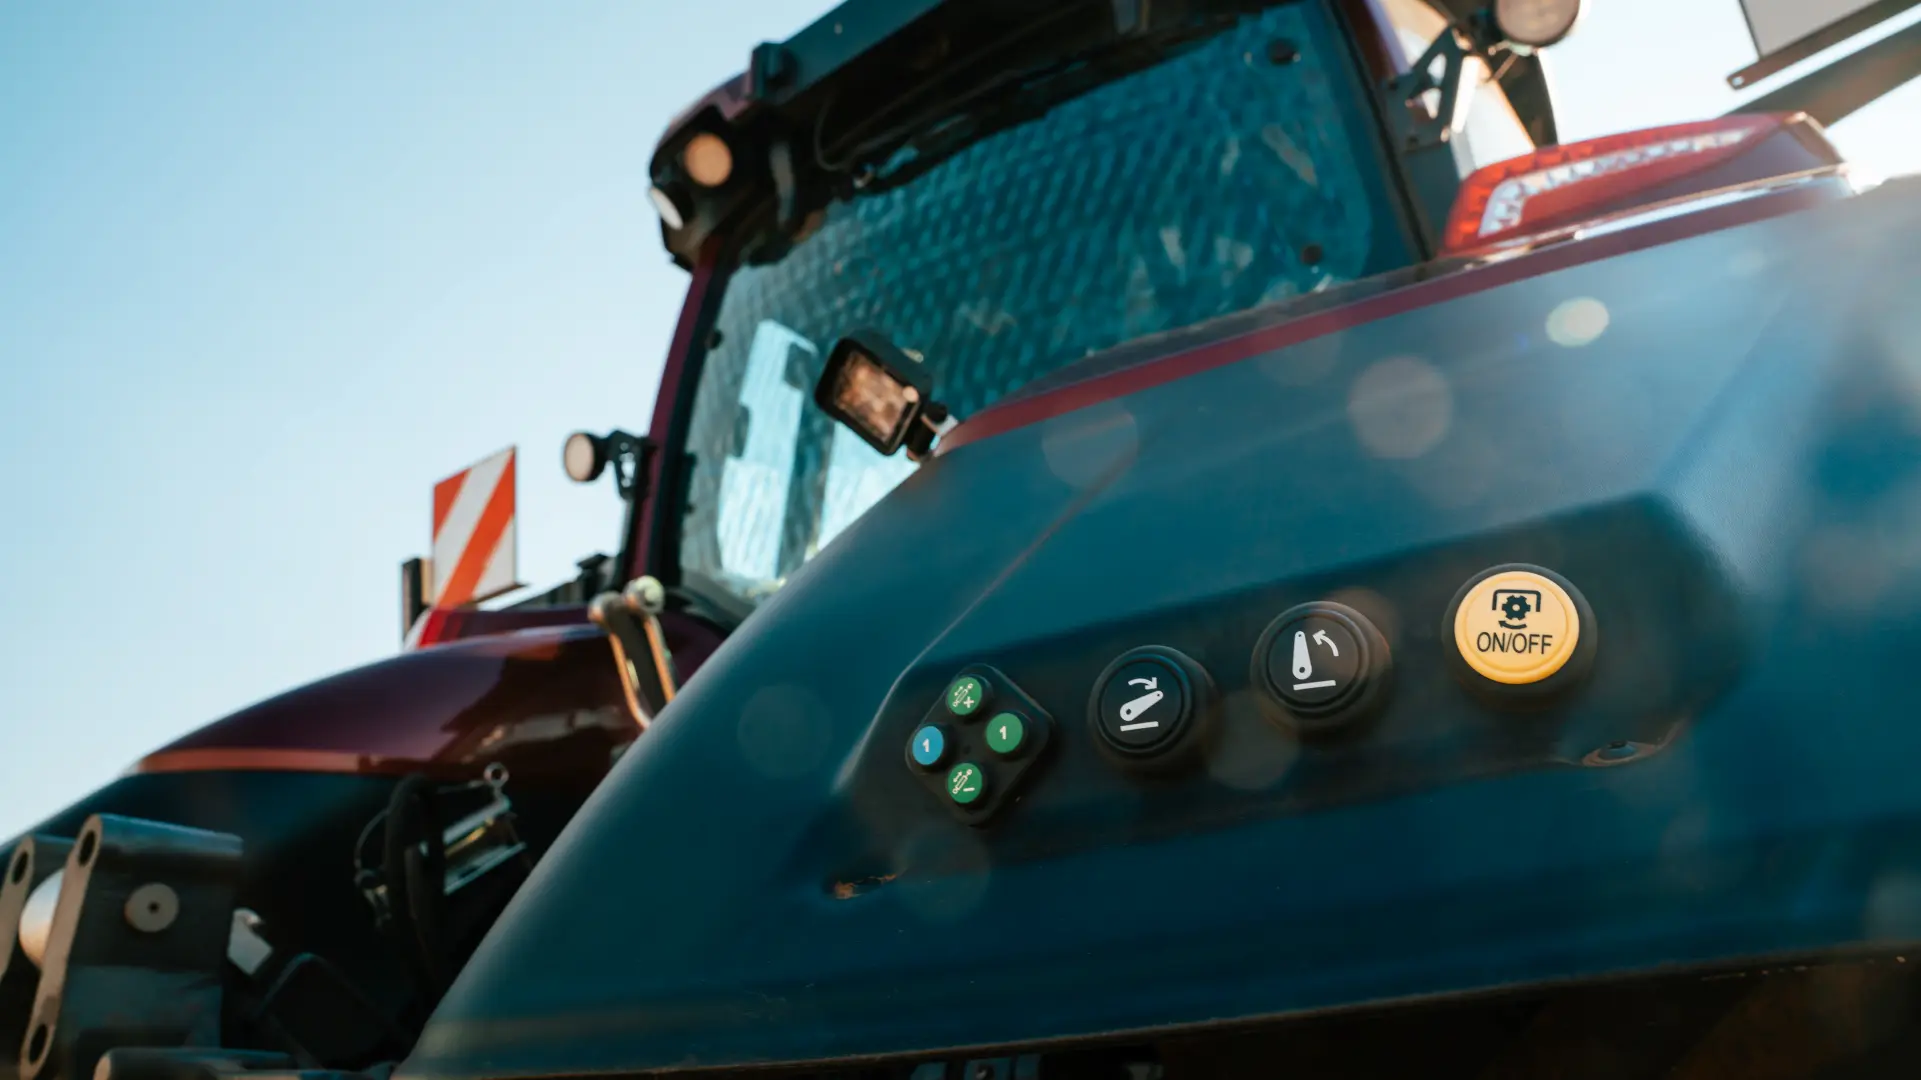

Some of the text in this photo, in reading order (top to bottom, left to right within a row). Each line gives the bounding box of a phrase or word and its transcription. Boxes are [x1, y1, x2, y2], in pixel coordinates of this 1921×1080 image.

[1477, 631, 1553, 654] ON/OFF
[999, 725, 1007, 740] 1
[922, 738, 930, 753] 1
